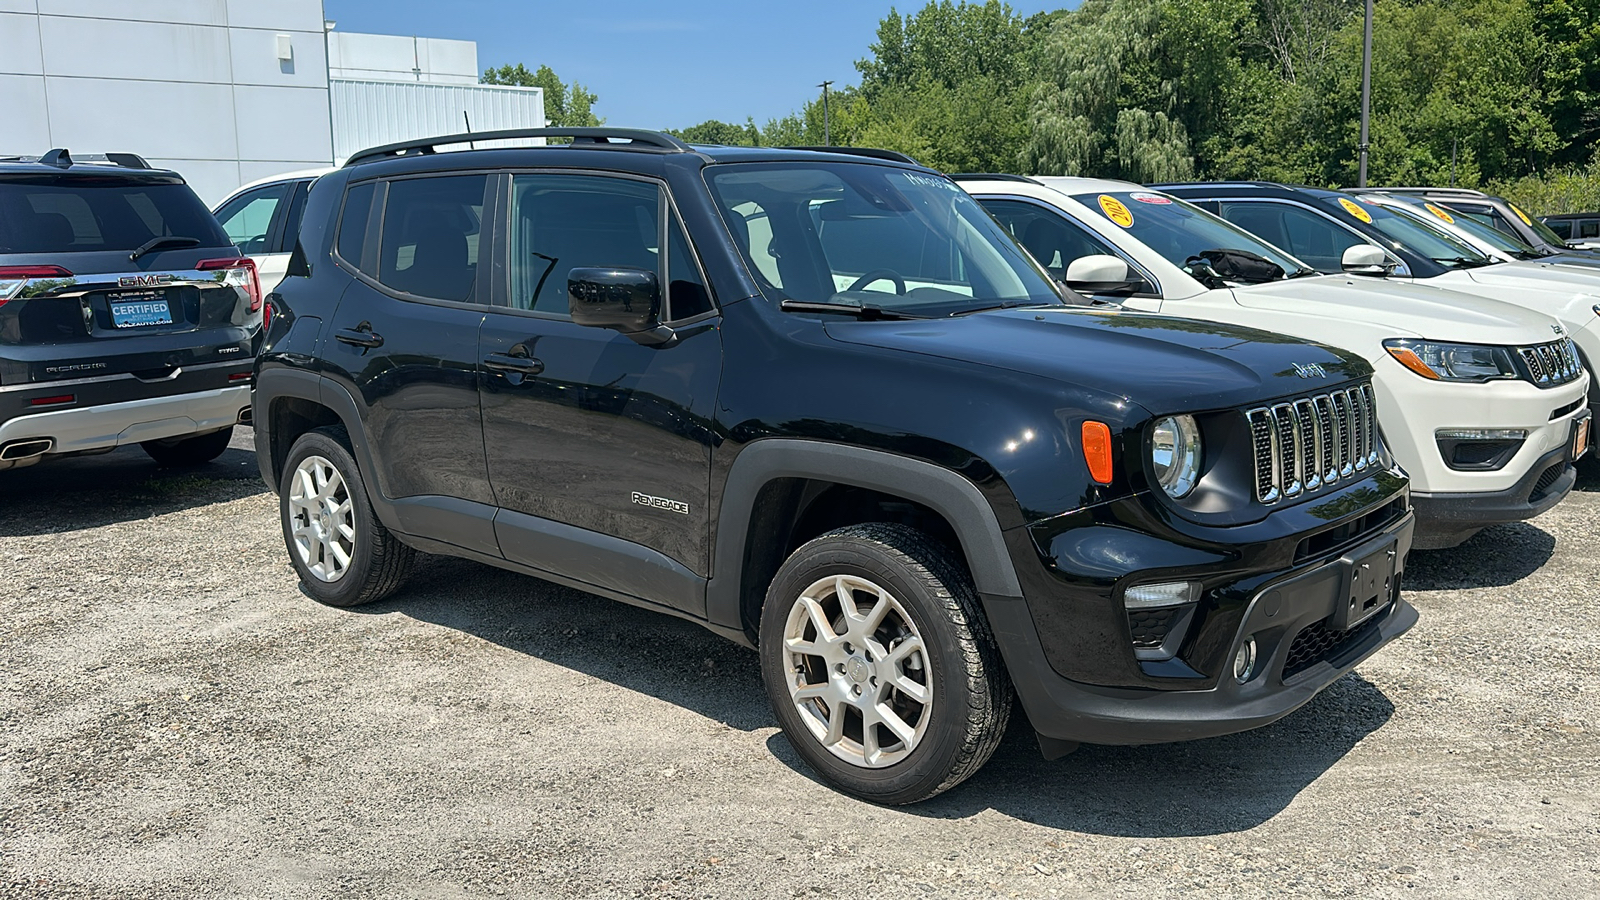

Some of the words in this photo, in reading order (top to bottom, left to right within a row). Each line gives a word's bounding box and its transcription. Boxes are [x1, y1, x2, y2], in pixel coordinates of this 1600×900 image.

[118, 274, 171, 287] GMC
[112, 303, 168, 315] CERTIFIED
[116, 319, 173, 328] VOLZAUTO.COM
[218, 346, 240, 354] AWD
[46, 362, 107, 373] ACADIA
[1291, 362, 1326, 379] Jeep
[631, 491, 690, 515] RENEGADE
